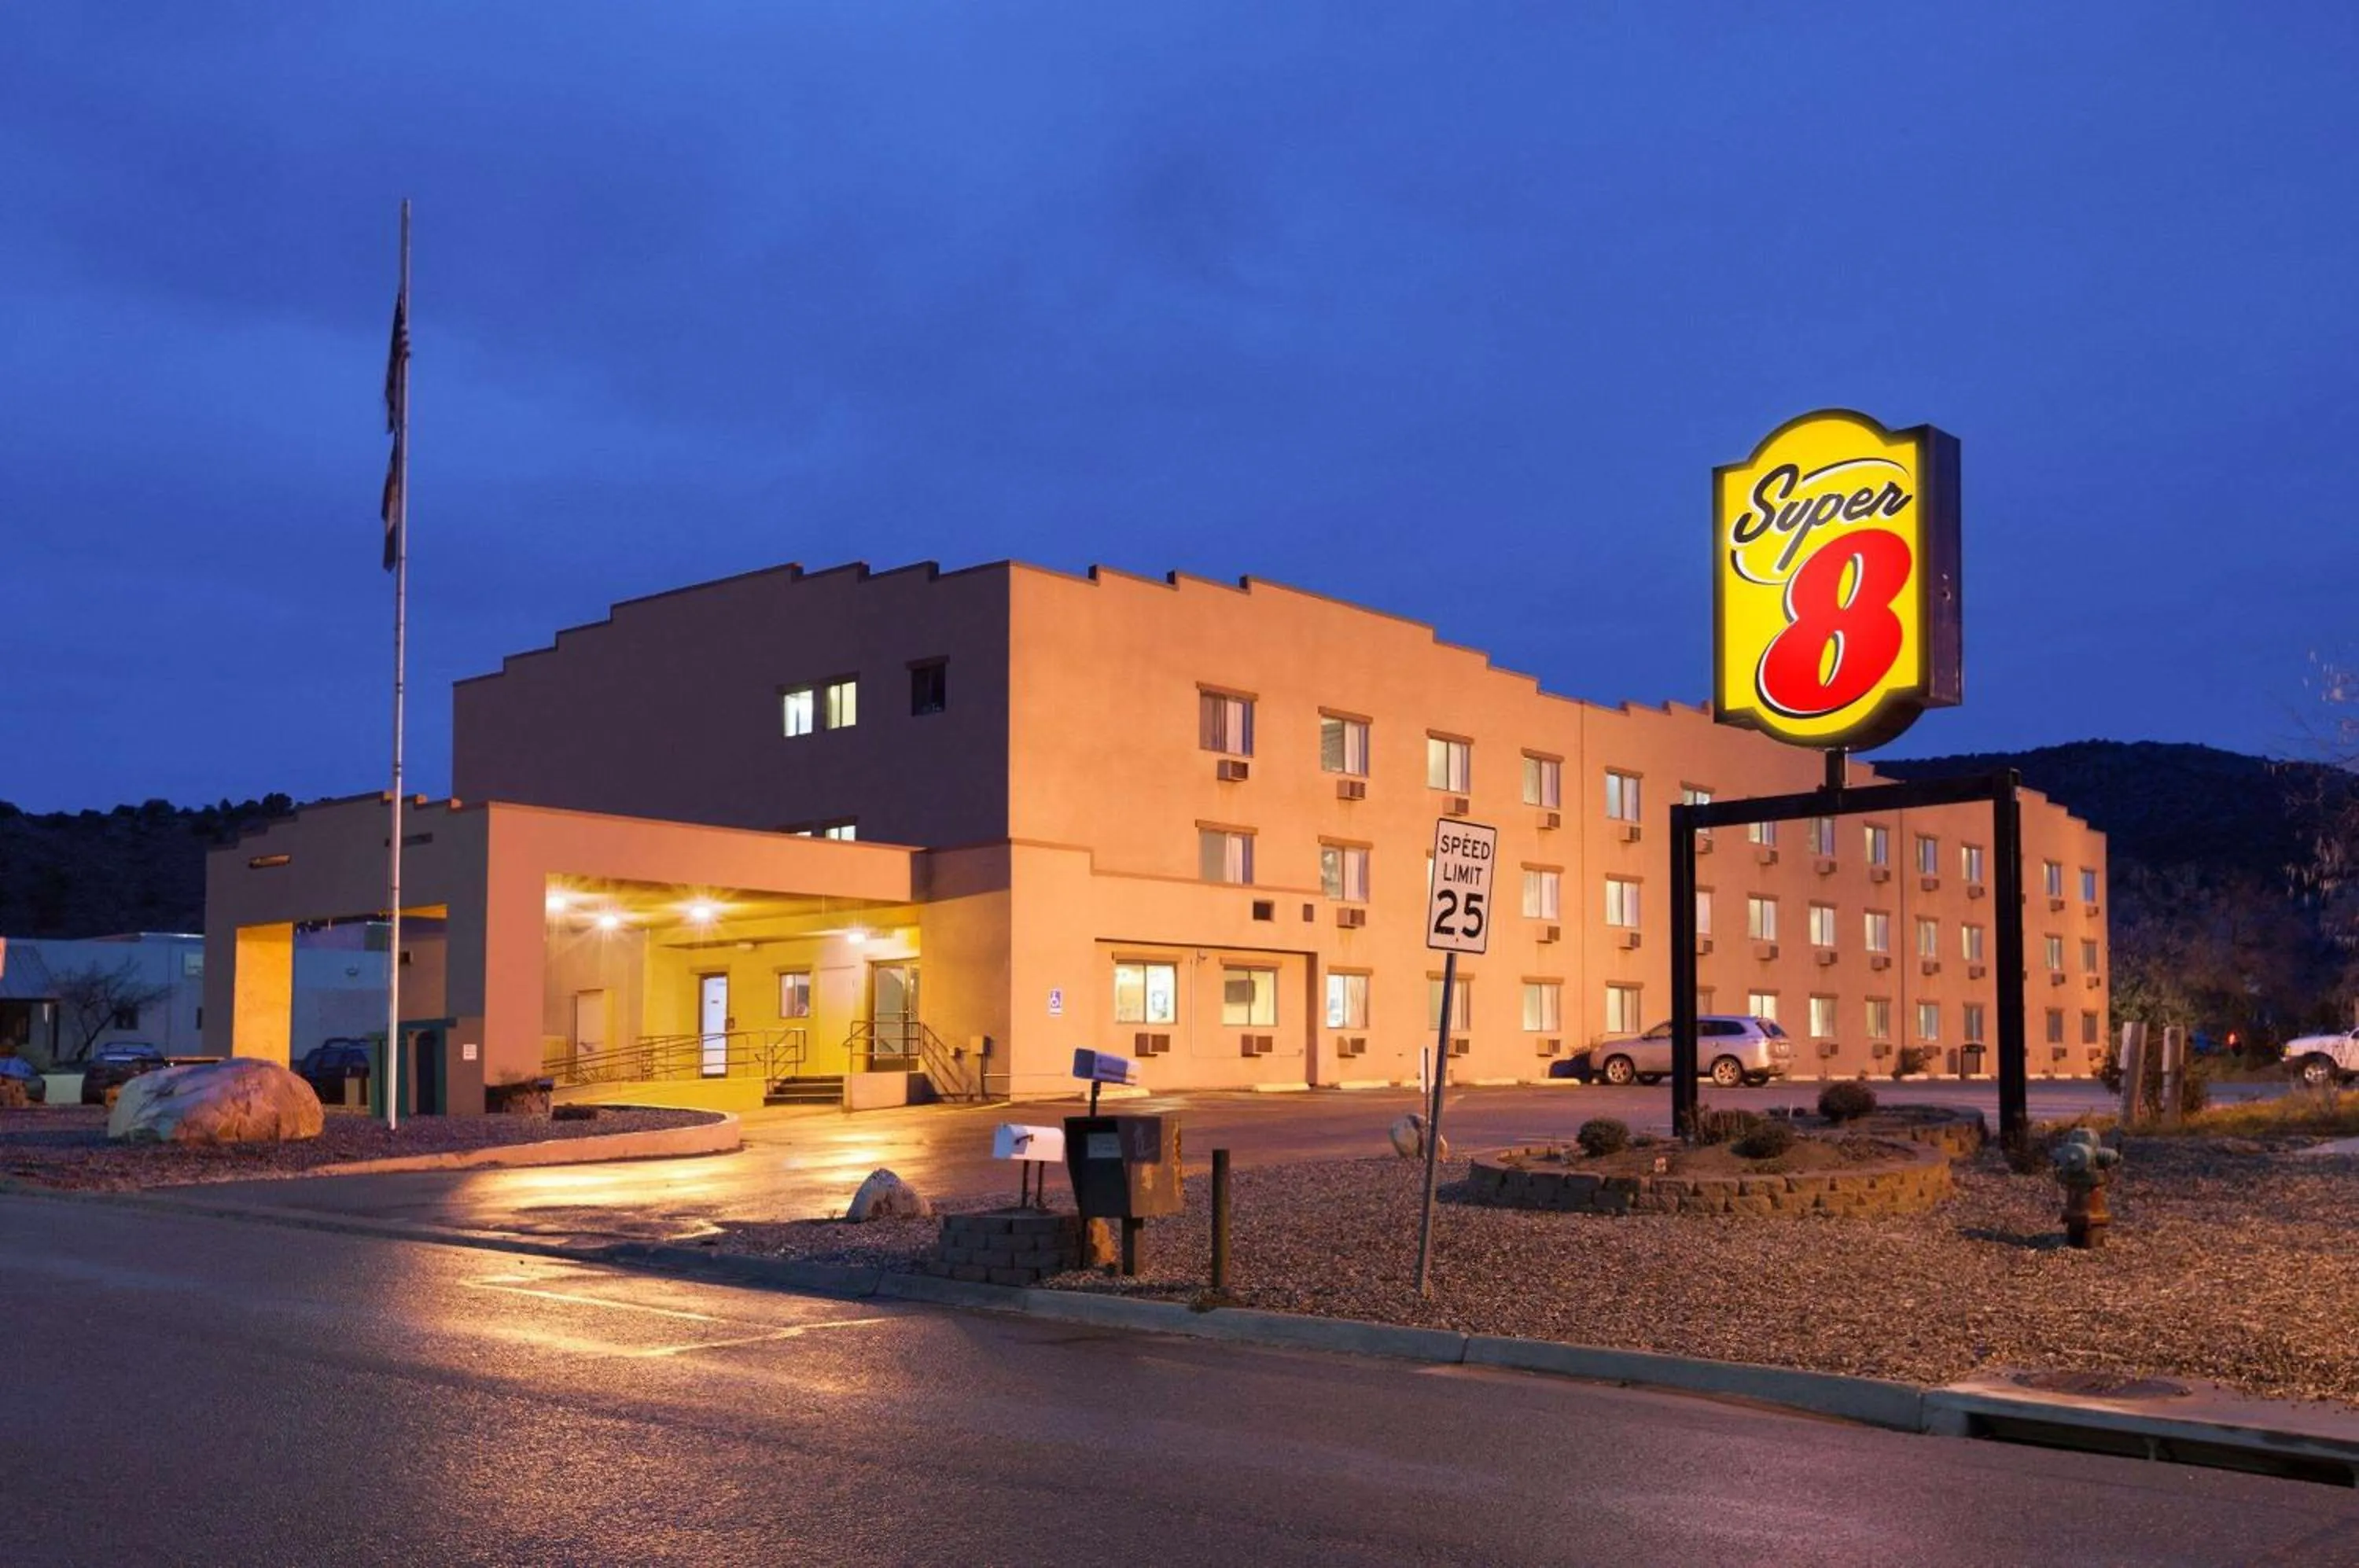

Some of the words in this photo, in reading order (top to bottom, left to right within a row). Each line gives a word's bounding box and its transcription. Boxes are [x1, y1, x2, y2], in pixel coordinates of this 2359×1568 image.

[1732, 462, 1912, 572] Super
[1754, 528, 1912, 720] 8
[1440, 835, 1490, 860] SPEED
[1443, 862, 1483, 886] LIMIT
[1433, 889, 1484, 939] 25
